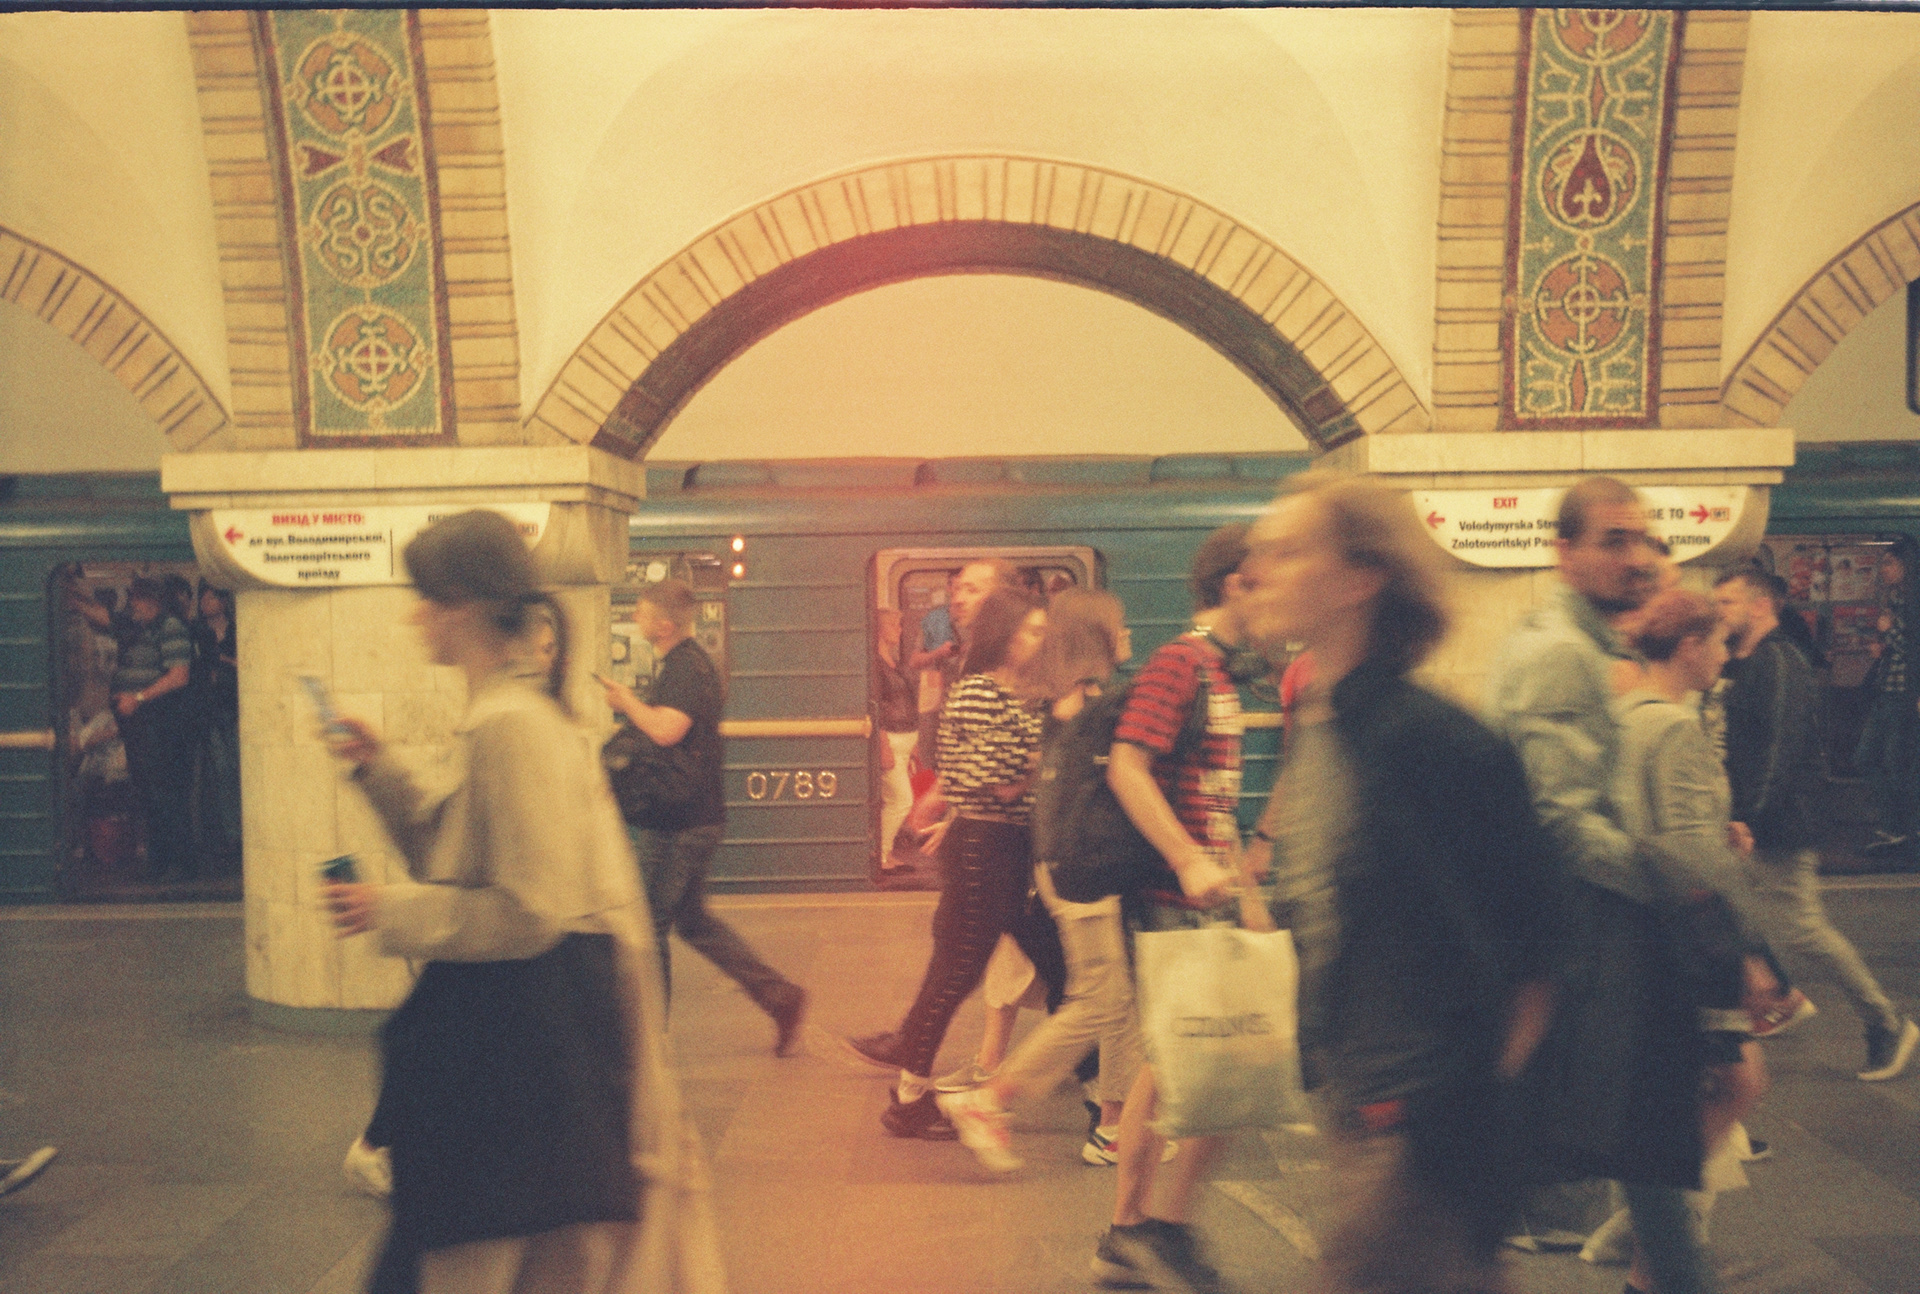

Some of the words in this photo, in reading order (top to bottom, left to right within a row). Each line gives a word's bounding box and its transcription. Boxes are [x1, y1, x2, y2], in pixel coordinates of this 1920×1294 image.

[1493, 497, 1518, 509] EXIT
[1669, 508, 1684, 519] TO
[272, 514, 309, 526] ВИХІД
[313, 514, 319, 524] У
[1459, 520, 1533, 532] Volodymyrska
[1537, 520, 1560, 530] Stre
[1668, 535, 1711, 545] STATION
[746, 771, 838, 800] 0789
